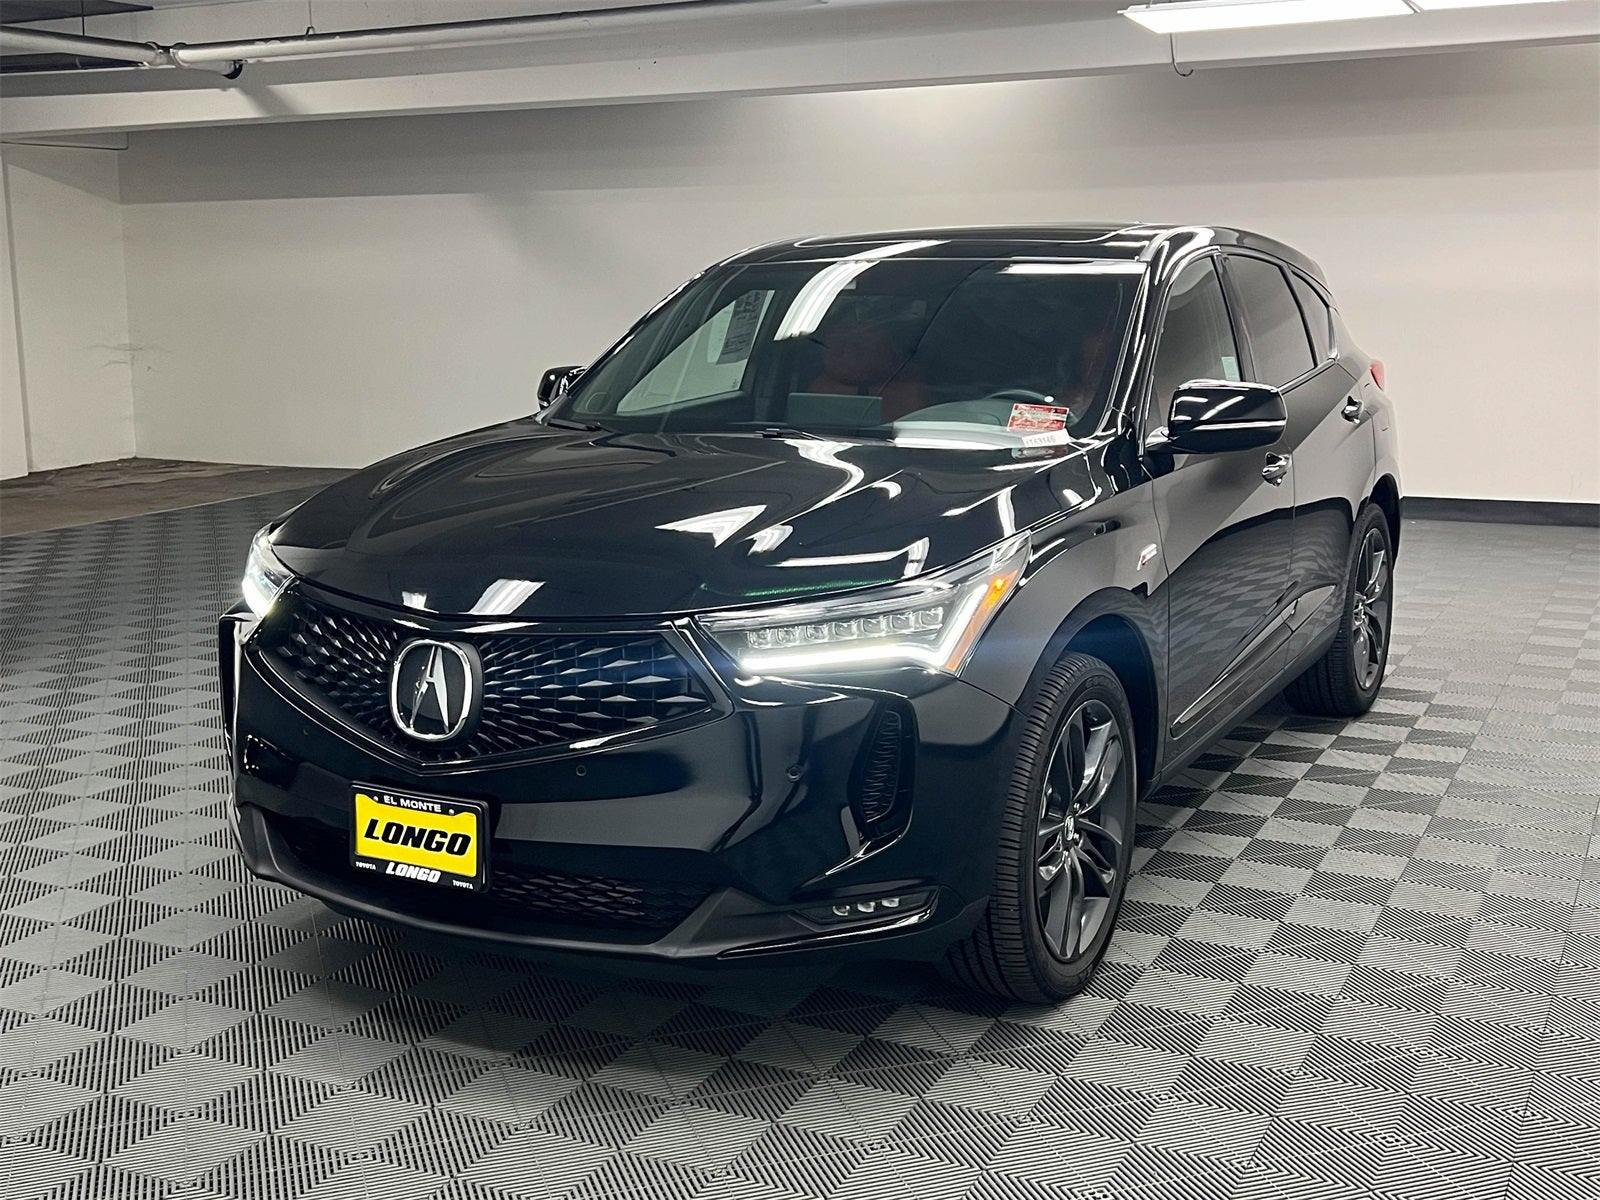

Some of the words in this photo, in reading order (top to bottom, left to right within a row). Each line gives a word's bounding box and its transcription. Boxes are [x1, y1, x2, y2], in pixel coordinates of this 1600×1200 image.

[383, 795, 398, 805] EL
[400, 798, 442, 813] MONTE
[364, 818, 471, 856] LONGO
[355, 861, 377, 870] TOYOTA
[385, 862, 441, 883] LONGO
[452, 880, 474, 890] TOYOTA
